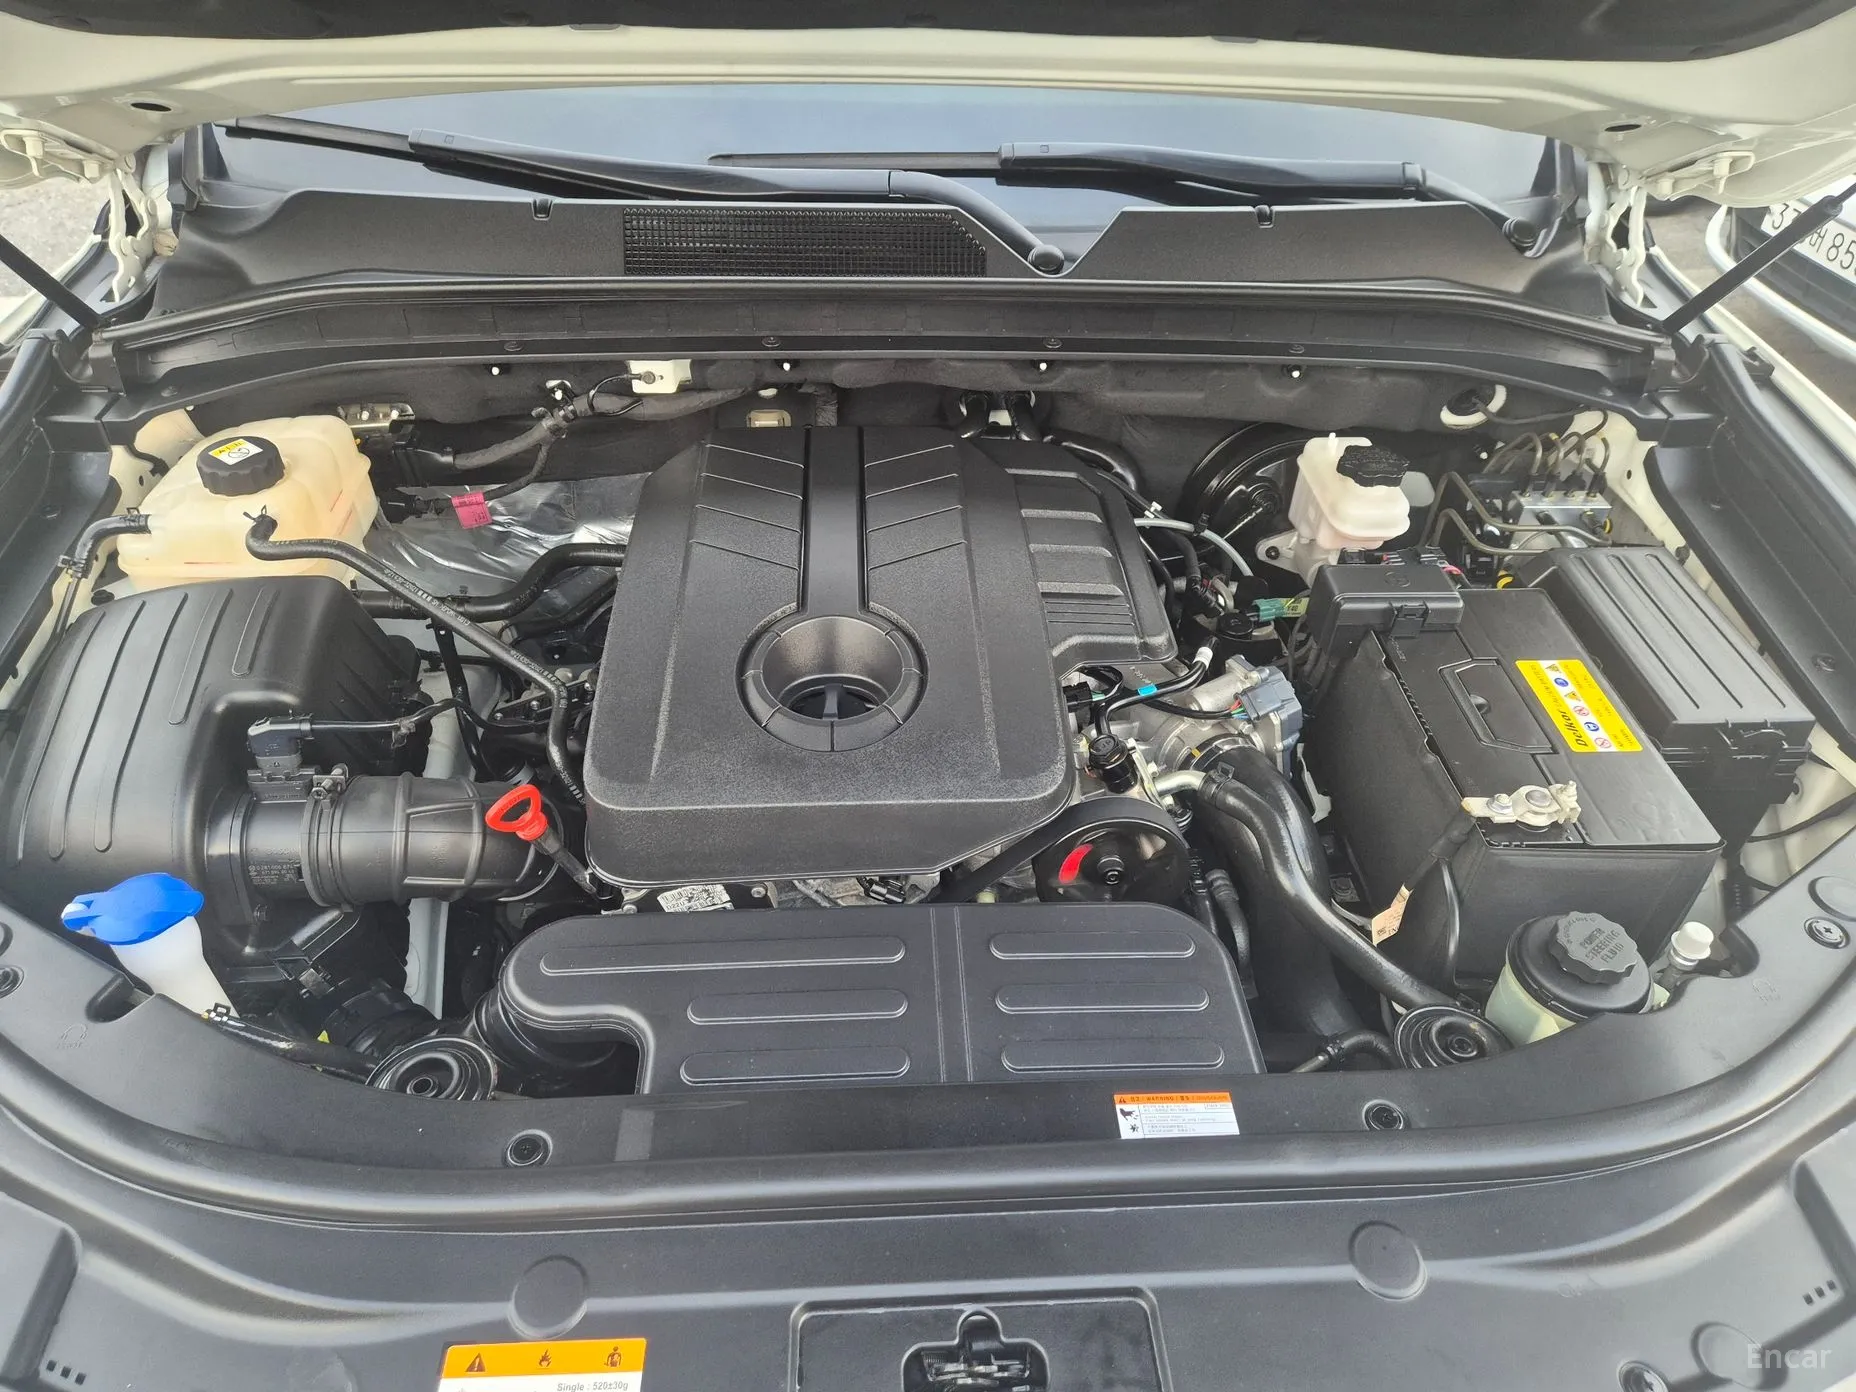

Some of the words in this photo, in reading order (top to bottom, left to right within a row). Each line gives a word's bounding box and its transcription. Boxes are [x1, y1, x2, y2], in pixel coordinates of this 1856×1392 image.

[1827, 232, 1856, 275] 85
[1559, 710, 1588, 747] Delkor
[1579, 928, 1605, 948] POWER
[1585, 929, 1621, 961] STEERING
[1600, 943, 1625, 963] FLUID
[557, 1383, 584, 1392] Single
[593, 1382, 628, 1391] 520±30g
